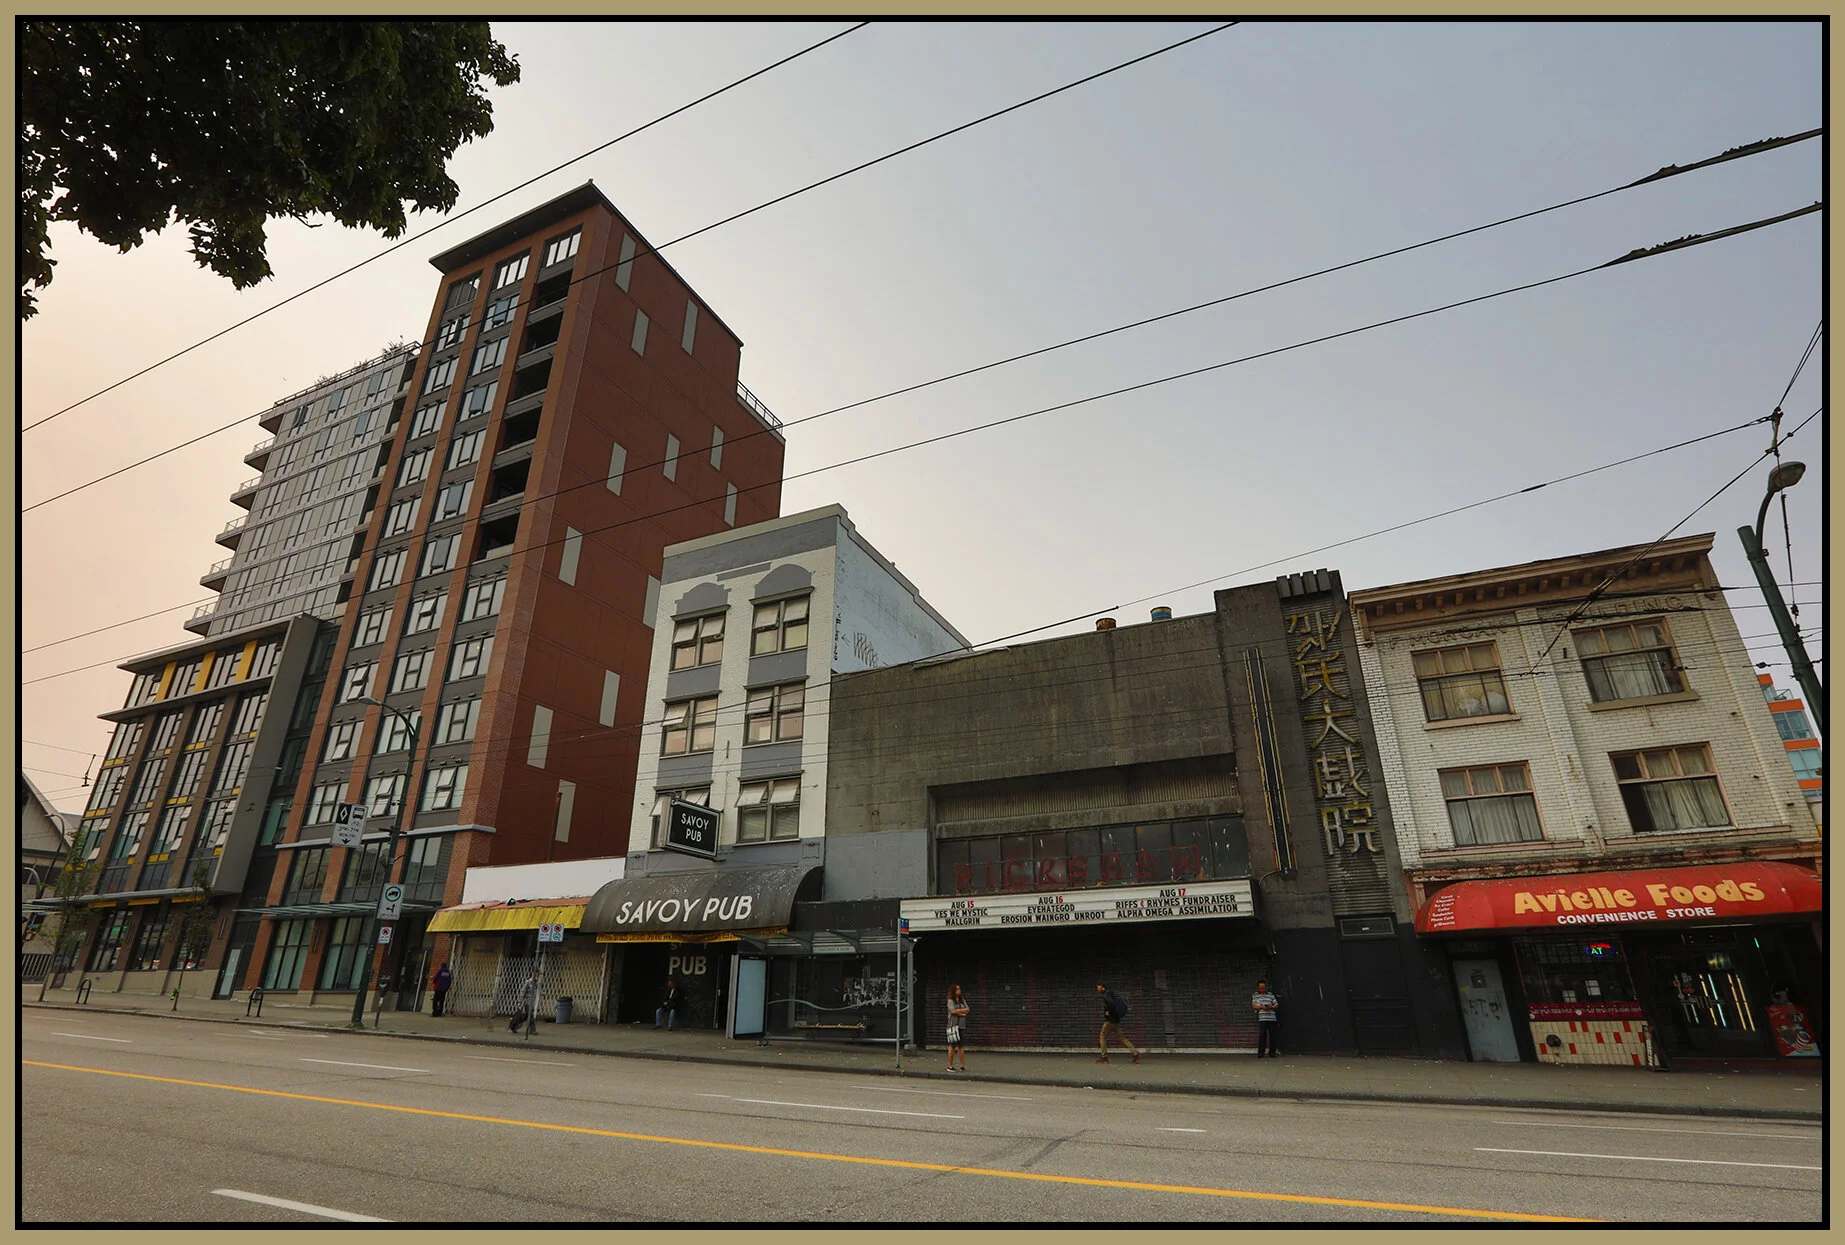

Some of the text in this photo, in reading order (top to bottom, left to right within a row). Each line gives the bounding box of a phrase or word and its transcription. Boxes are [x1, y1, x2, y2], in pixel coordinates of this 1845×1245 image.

[681, 812, 710, 831] SAVOY
[685, 828, 702, 843] PUB
[954, 846, 1201, 890] RICKSHAW
[1159, 887, 1187, 898] AUG 17
[1513, 879, 1766, 915] Avielle Foods
[951, 900, 975, 910] AUG 15
[1038, 895, 1064, 906] AUG 16
[1115, 900, 1138, 910] RIFFS
[1147, 897, 1180, 909] RHYMES
[1182, 894, 1237, 907] FUNDRAISER
[615, 895, 753, 925] SAVOY PUB
[934, 908, 988, 919] YES WE MYSTIC
[1027, 903, 1075, 915] EYEHATEGOD
[1117, 903, 1239, 919] ALPHA OMEGA ASSIMILATION
[1556, 906, 1717, 926] CONVENIENCE STORE
[945, 917, 981, 927] WALLGRIN
[1000, 911, 1106, 924] EROSION WAINGRO UNROOT
[668, 957, 707, 976] PUB
